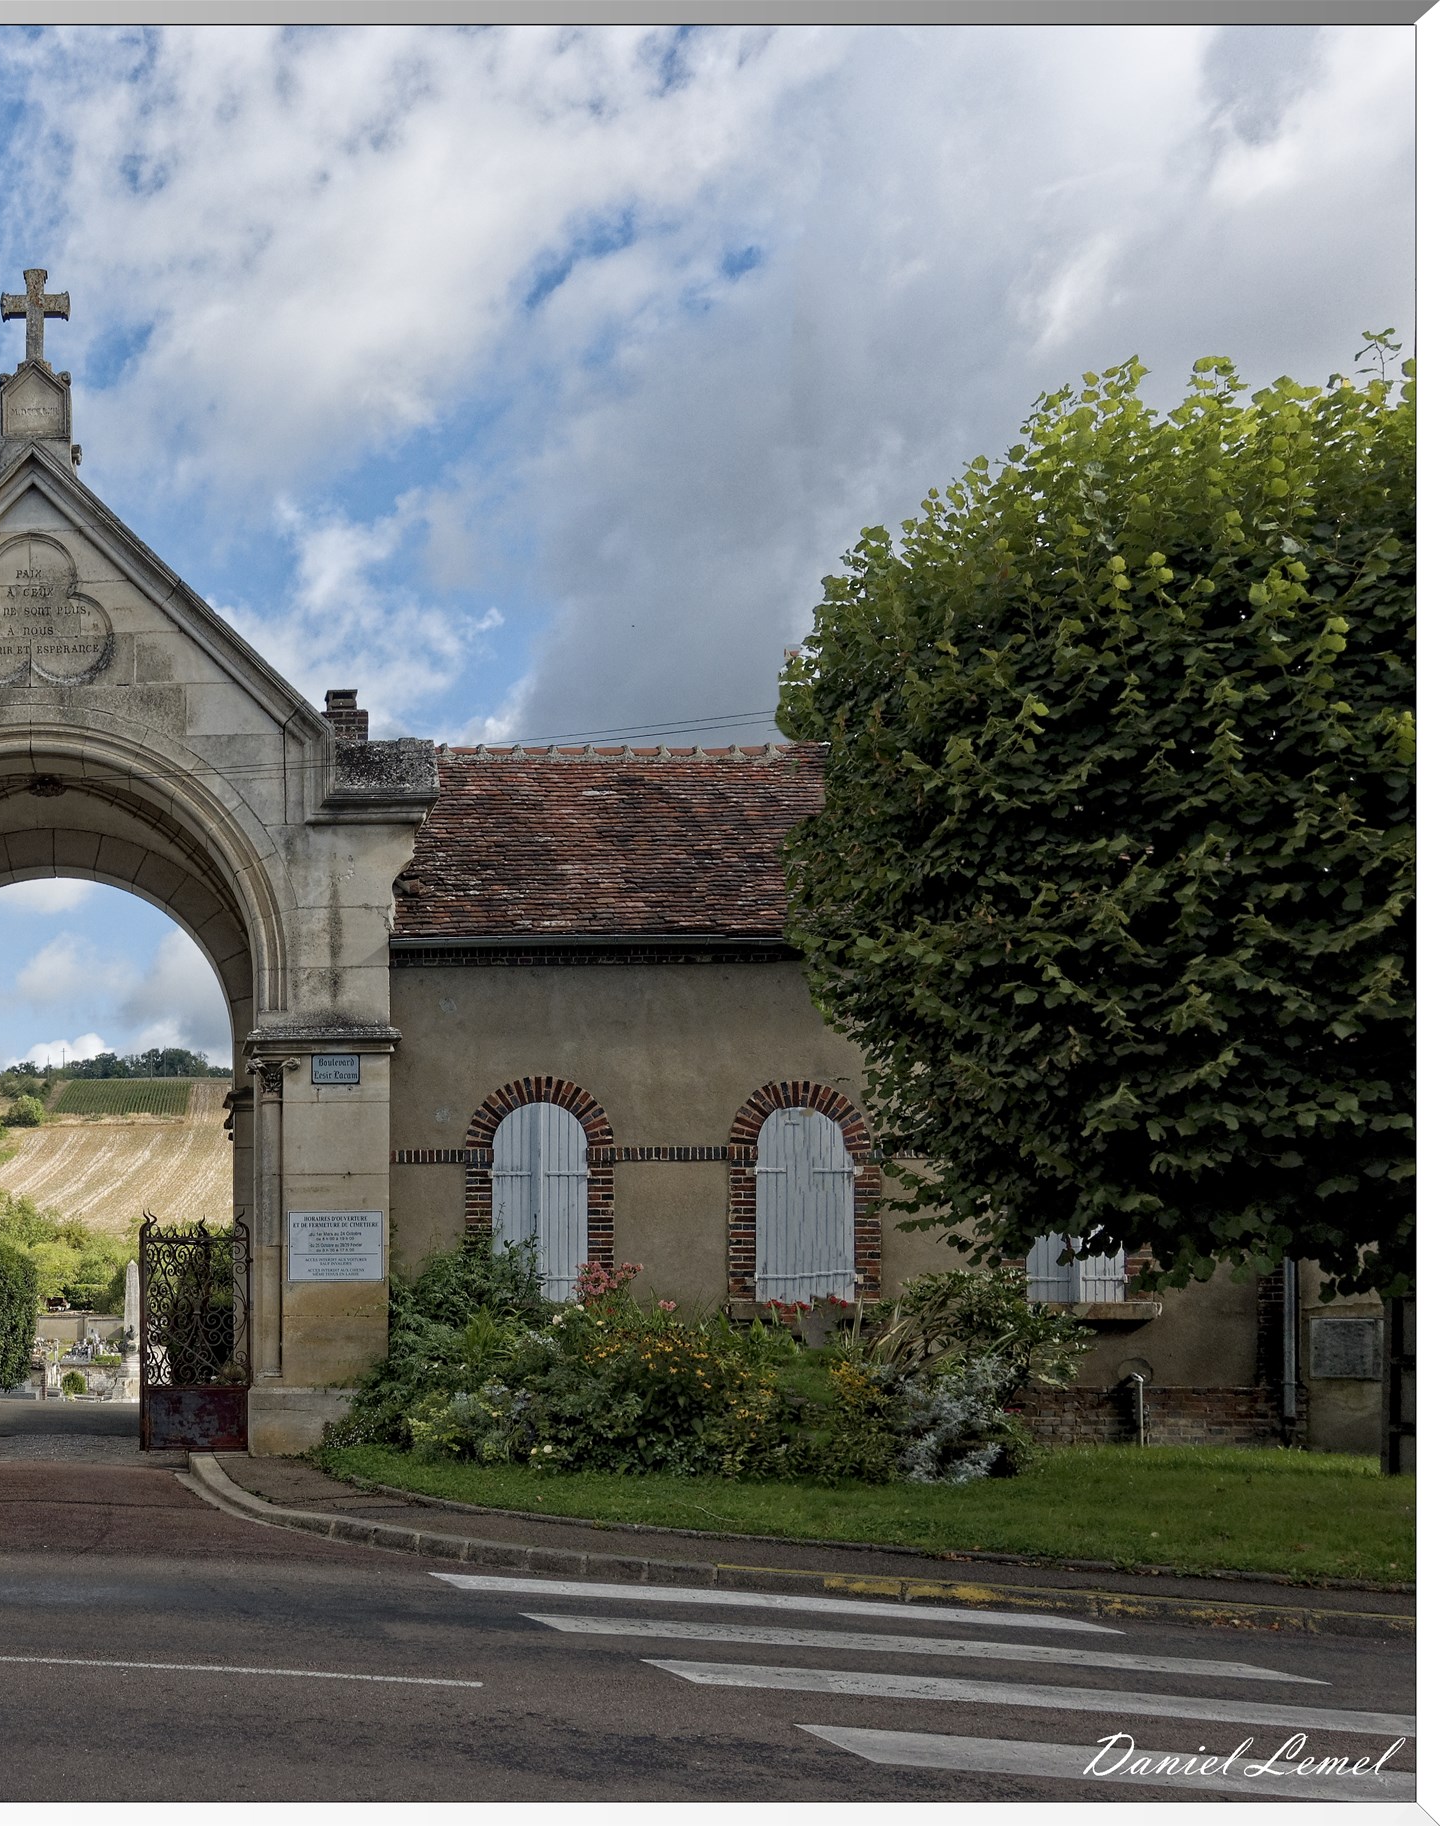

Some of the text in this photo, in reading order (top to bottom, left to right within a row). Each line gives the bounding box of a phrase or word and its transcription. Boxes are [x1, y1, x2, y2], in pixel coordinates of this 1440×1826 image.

[16, 569, 42, 578] PAIX
[23, 588, 54, 598] CEUX
[3, 607, 17, 616] NE
[24, 606, 52, 616] SONT
[23, 626, 54, 636] NOUS
[17, 645, 30, 655] ET
[317, 1057, 355, 1067] Boulevard
